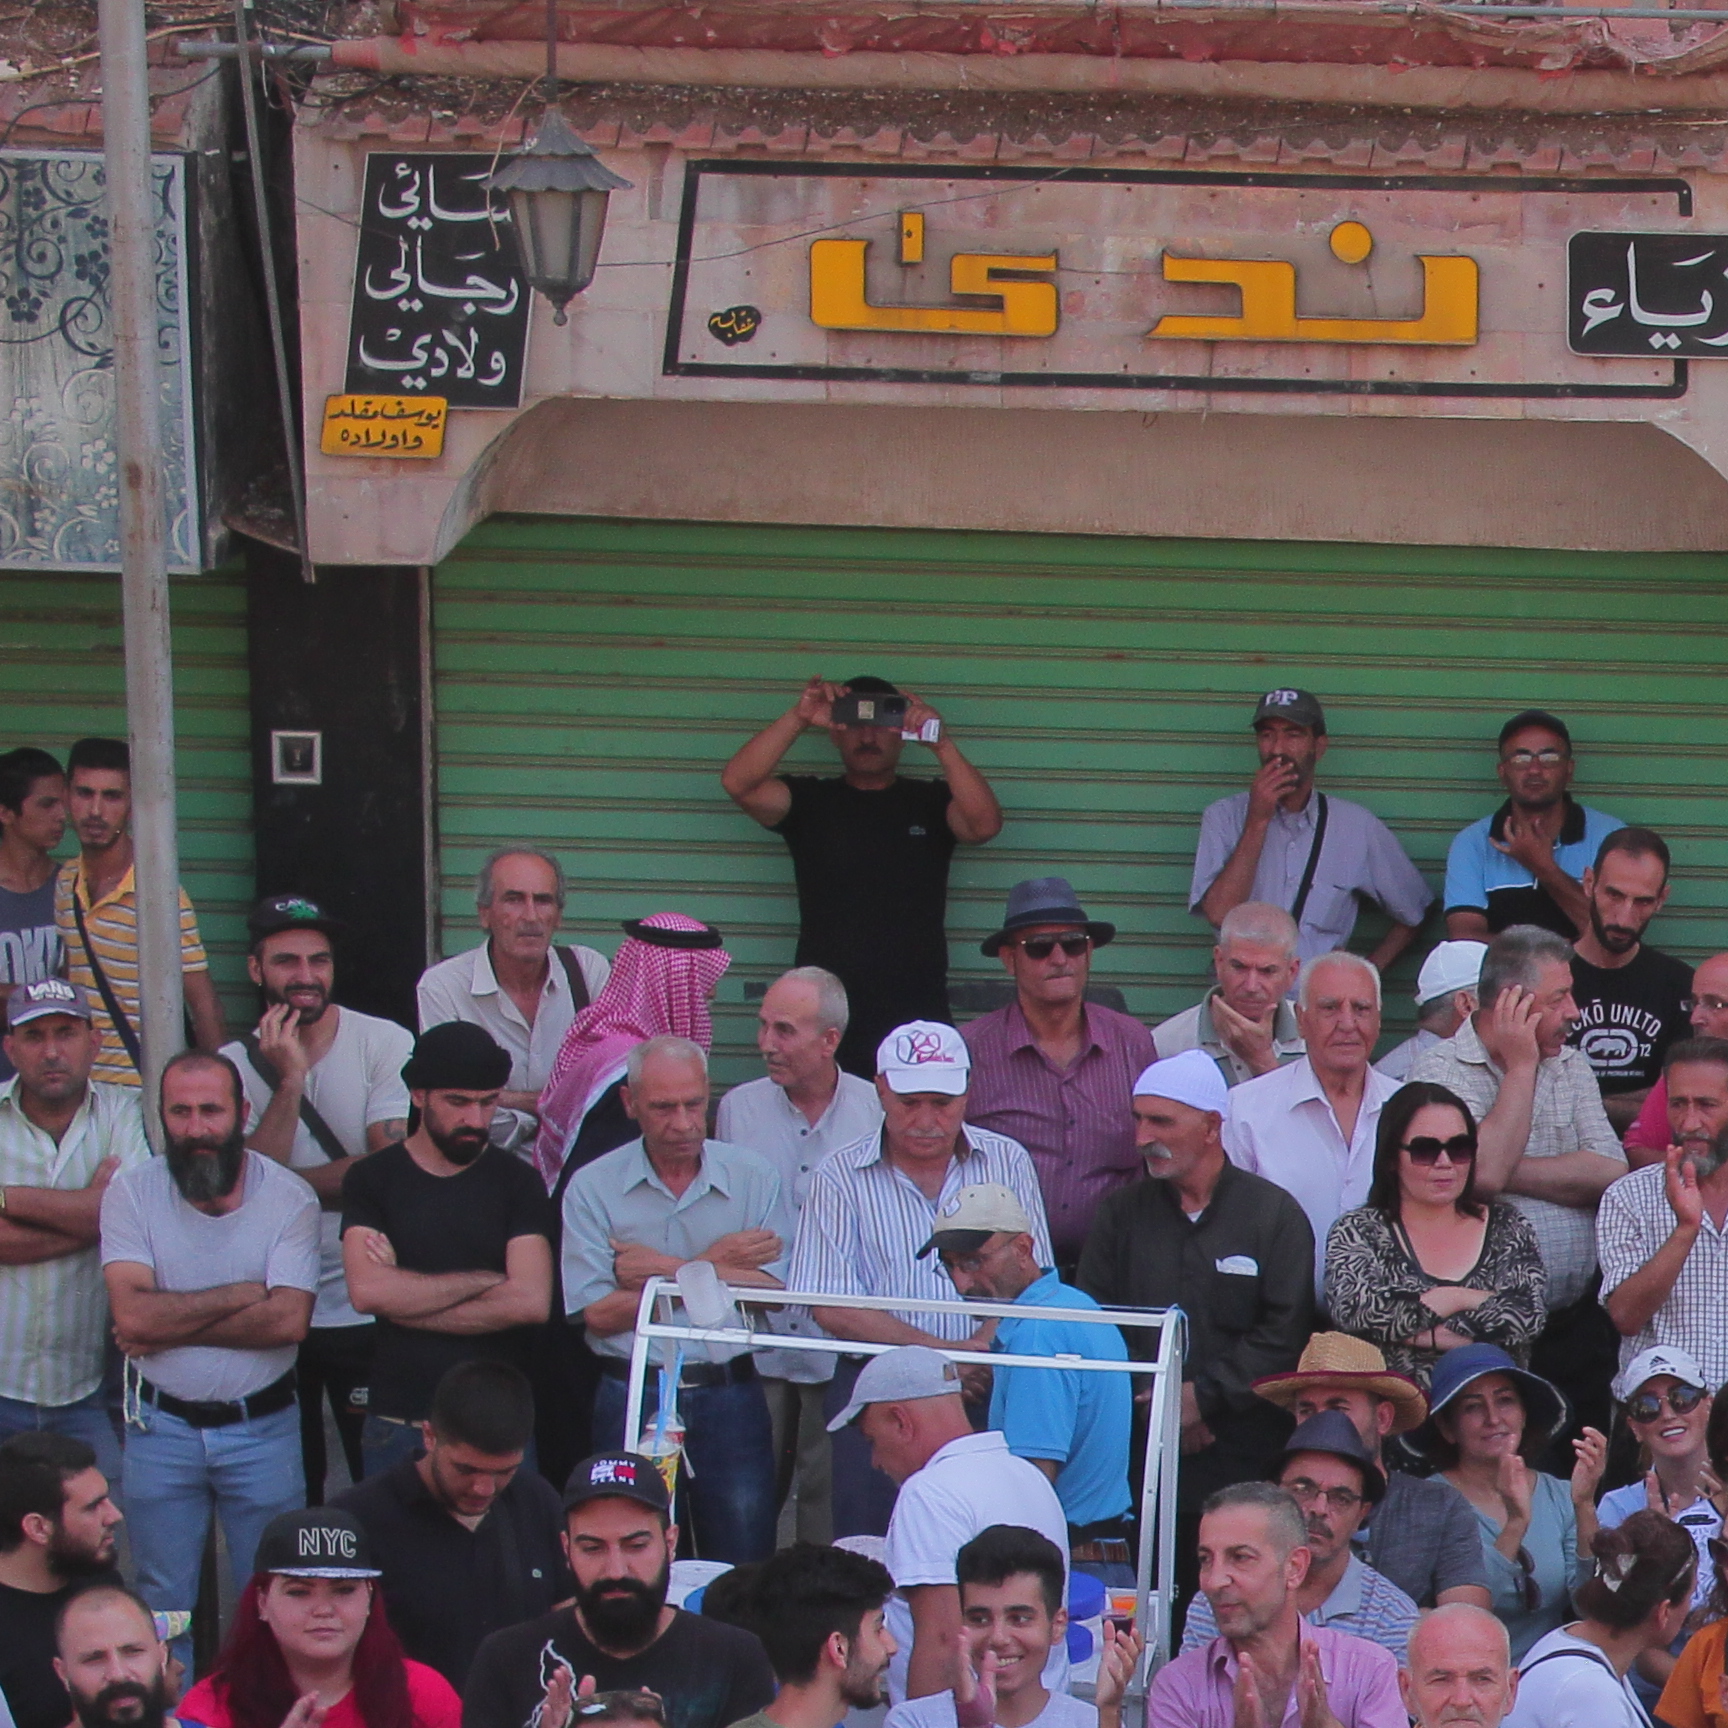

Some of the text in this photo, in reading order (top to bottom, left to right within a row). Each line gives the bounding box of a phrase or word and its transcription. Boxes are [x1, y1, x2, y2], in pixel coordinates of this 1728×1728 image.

[364, 235, 520, 316] رجالي
[358, 326, 507, 391] ولادي
[298, 1527, 357, 1559] NYC
